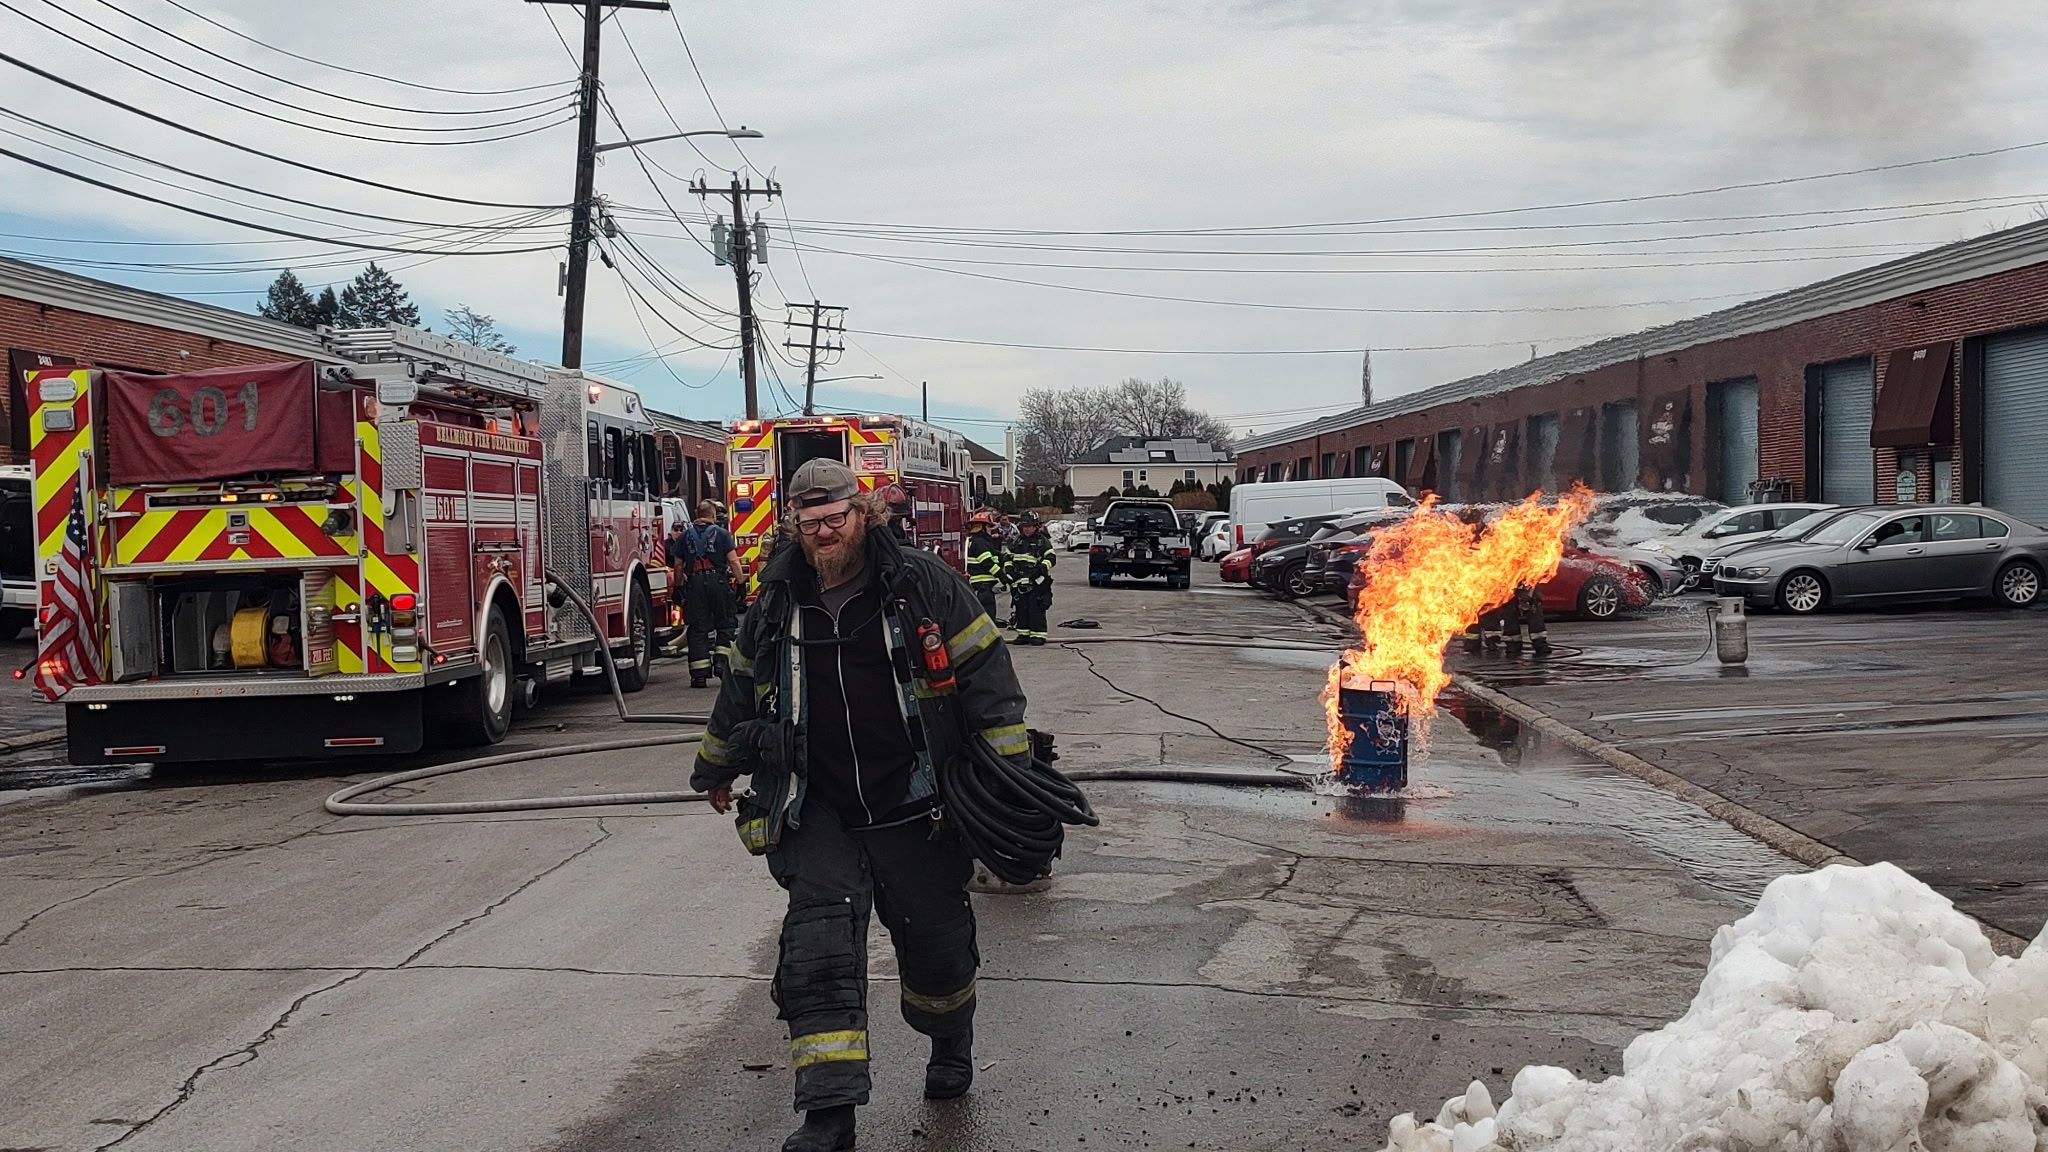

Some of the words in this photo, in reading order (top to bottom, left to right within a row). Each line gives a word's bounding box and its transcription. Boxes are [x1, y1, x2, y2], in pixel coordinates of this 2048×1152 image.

[148, 381, 259, 437] 601
[474, 432, 490, 449] FIRE
[491, 434, 530, 455] DEPARTMENT
[437, 496, 455, 520] 601
[738, 537, 758, 545] 653
